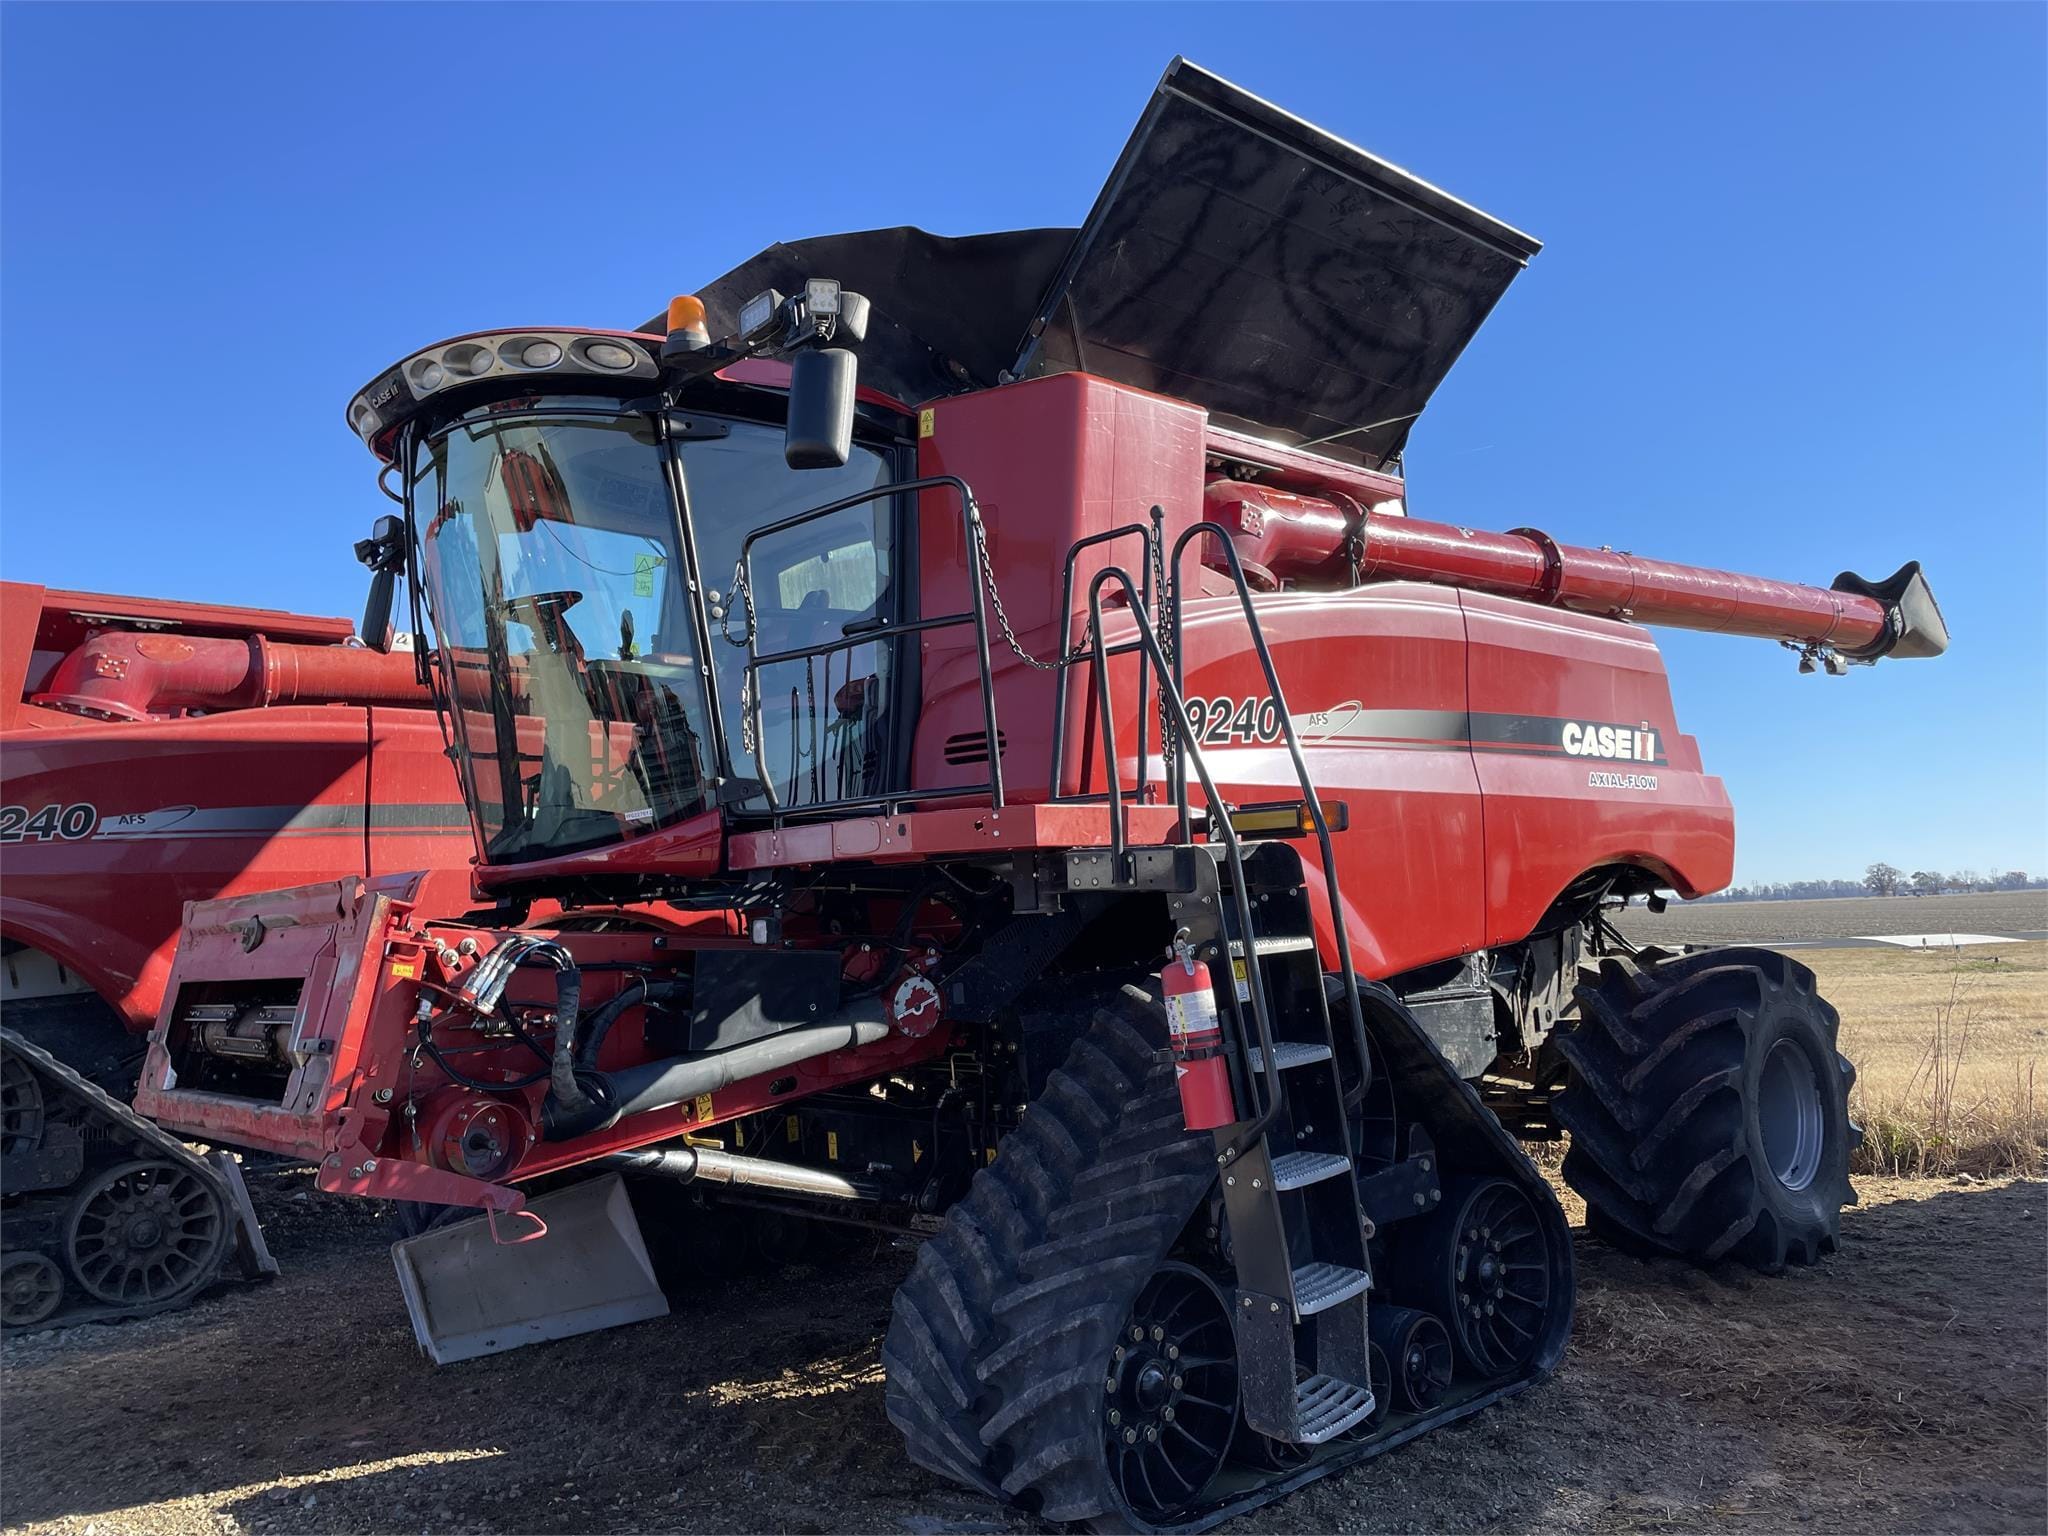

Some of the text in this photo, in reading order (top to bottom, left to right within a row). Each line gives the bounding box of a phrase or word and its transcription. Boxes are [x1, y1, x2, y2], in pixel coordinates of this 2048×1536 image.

[372, 388, 392, 409] CASE
[1184, 696, 1282, 745] 9240
[1308, 713, 1329, 726] AFS
[1562, 722, 1632, 759] CASE
[1588, 771, 1658, 791] AXIAL-FLOW
[118, 814, 147, 825] AFS
